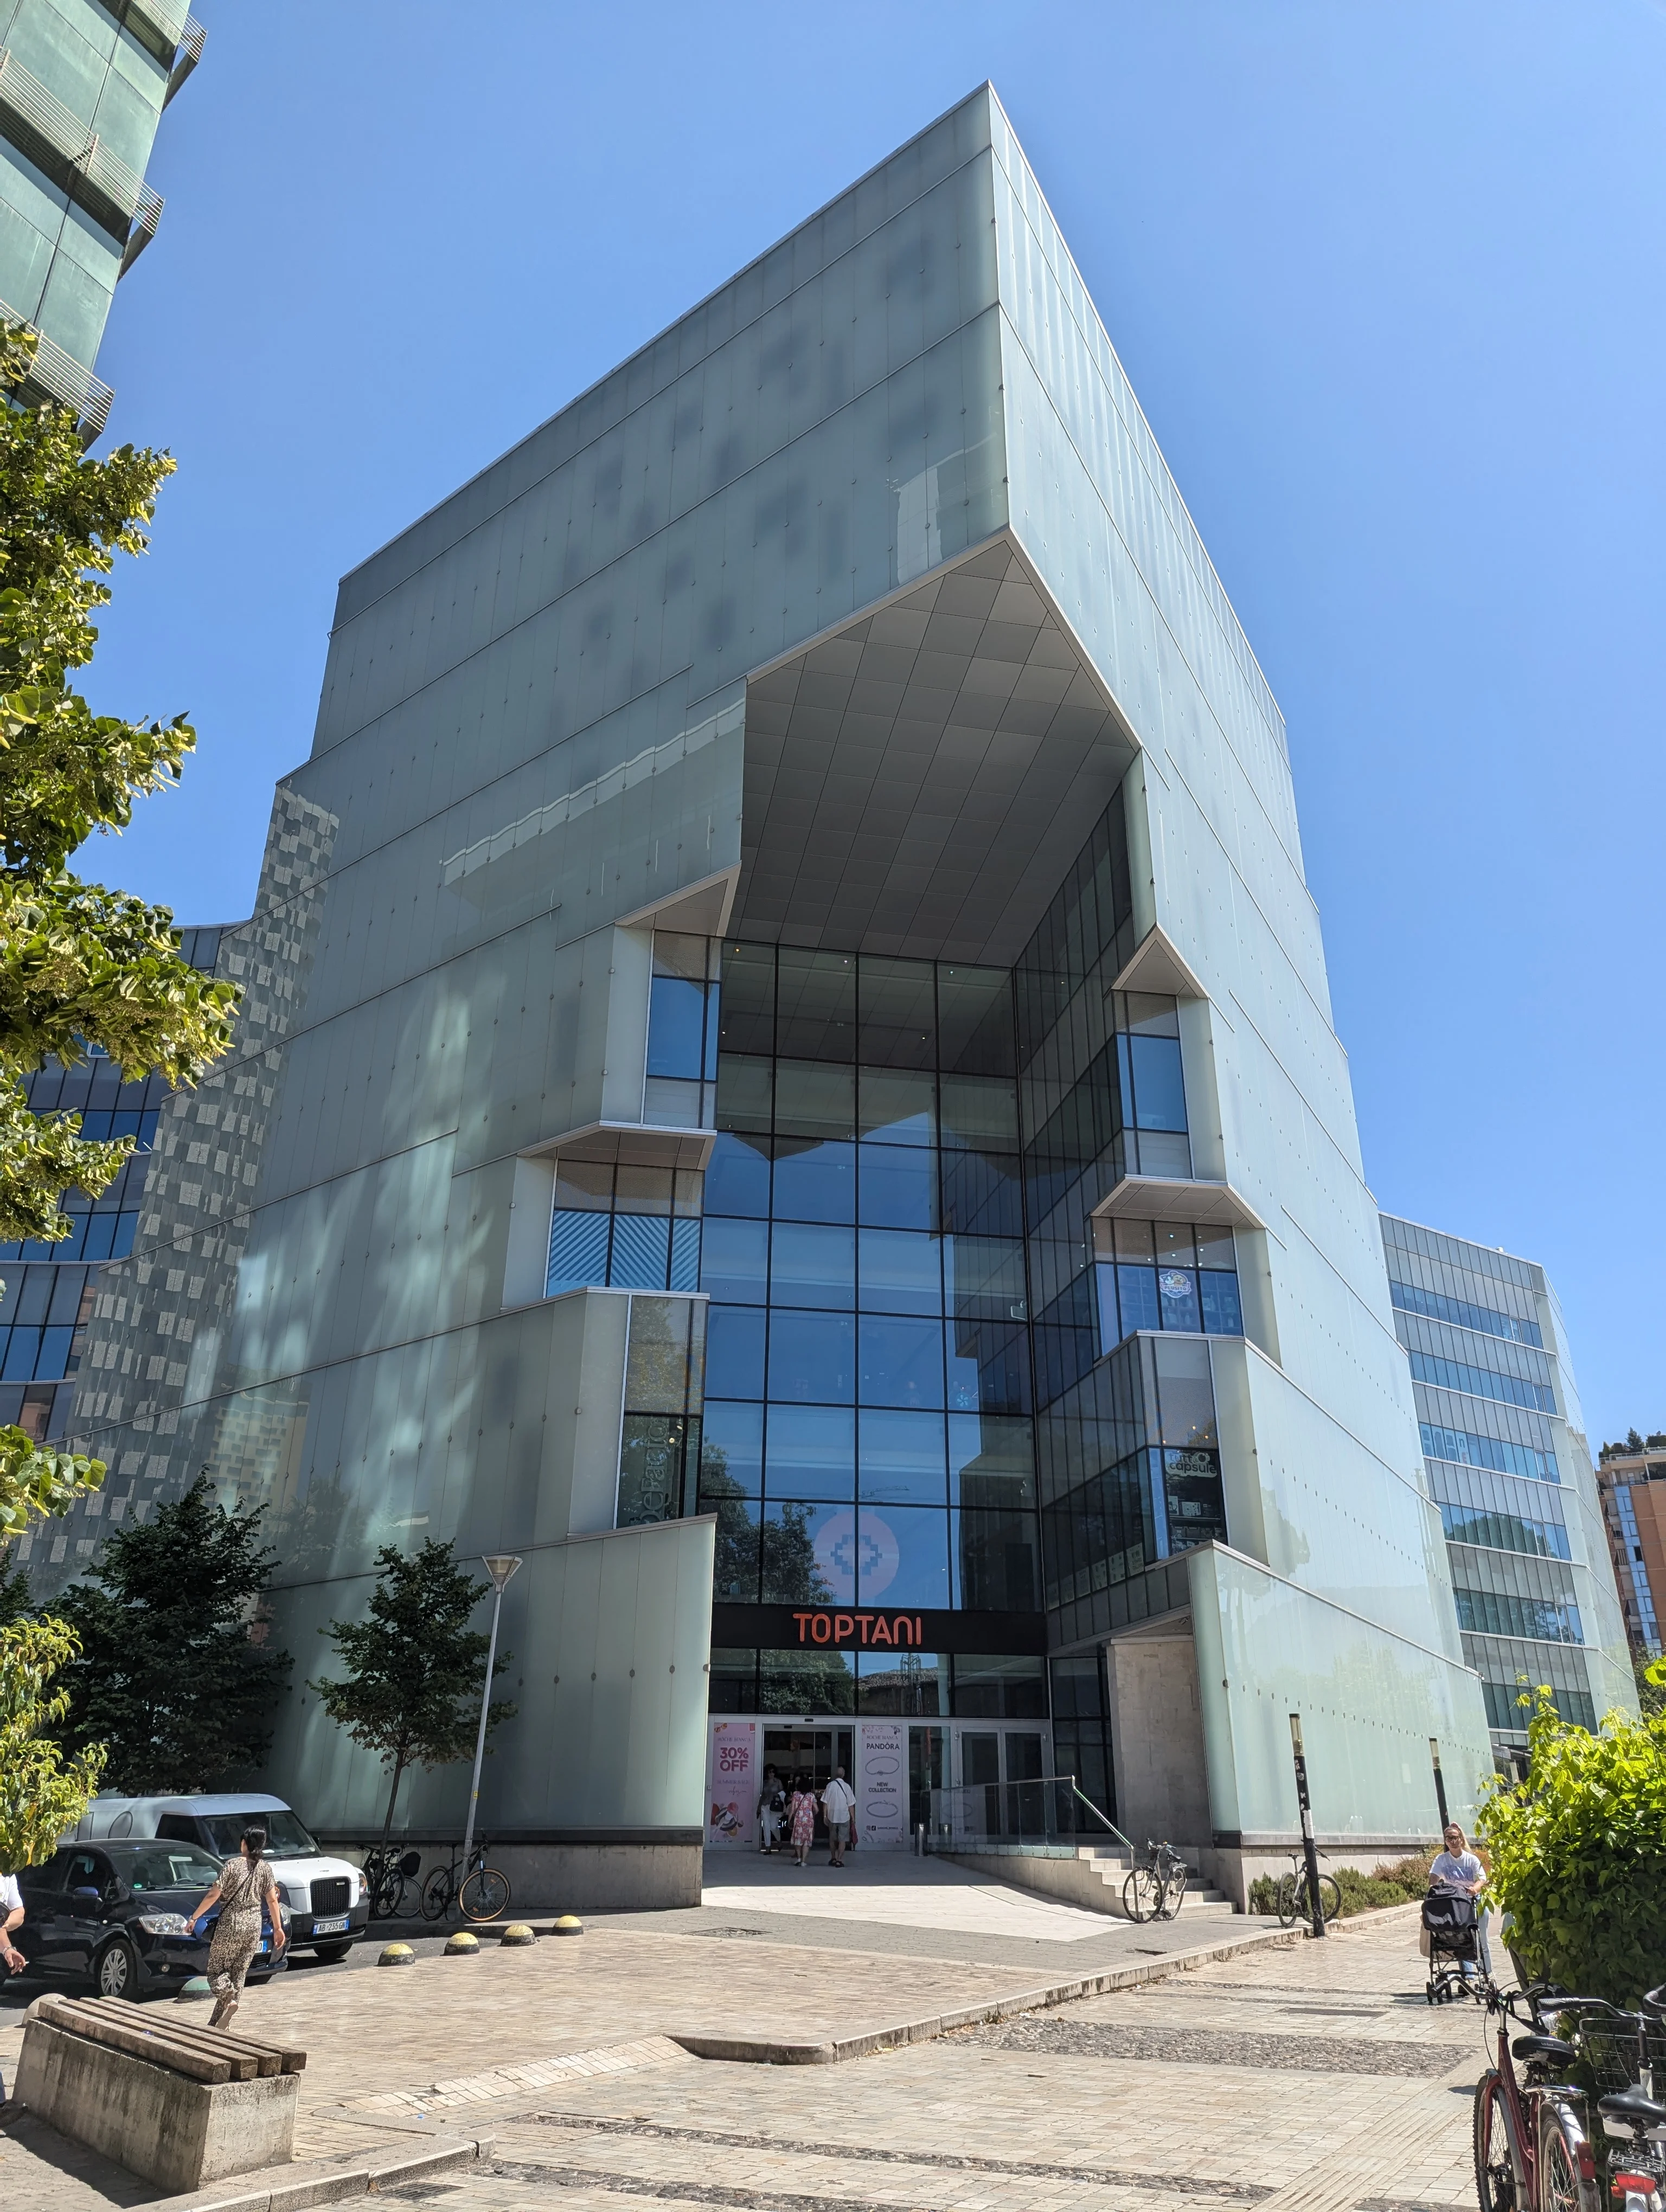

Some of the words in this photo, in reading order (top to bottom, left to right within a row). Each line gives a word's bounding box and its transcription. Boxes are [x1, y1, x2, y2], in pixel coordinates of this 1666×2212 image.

[1169, 1463, 1216, 1474] capsule
[793, 1613, 921, 1645] TOPTANI
[866, 1742, 900, 1750] PANDORA
[720, 1747, 749, 1759] 30%
[720, 1759, 748, 1772] OFF
